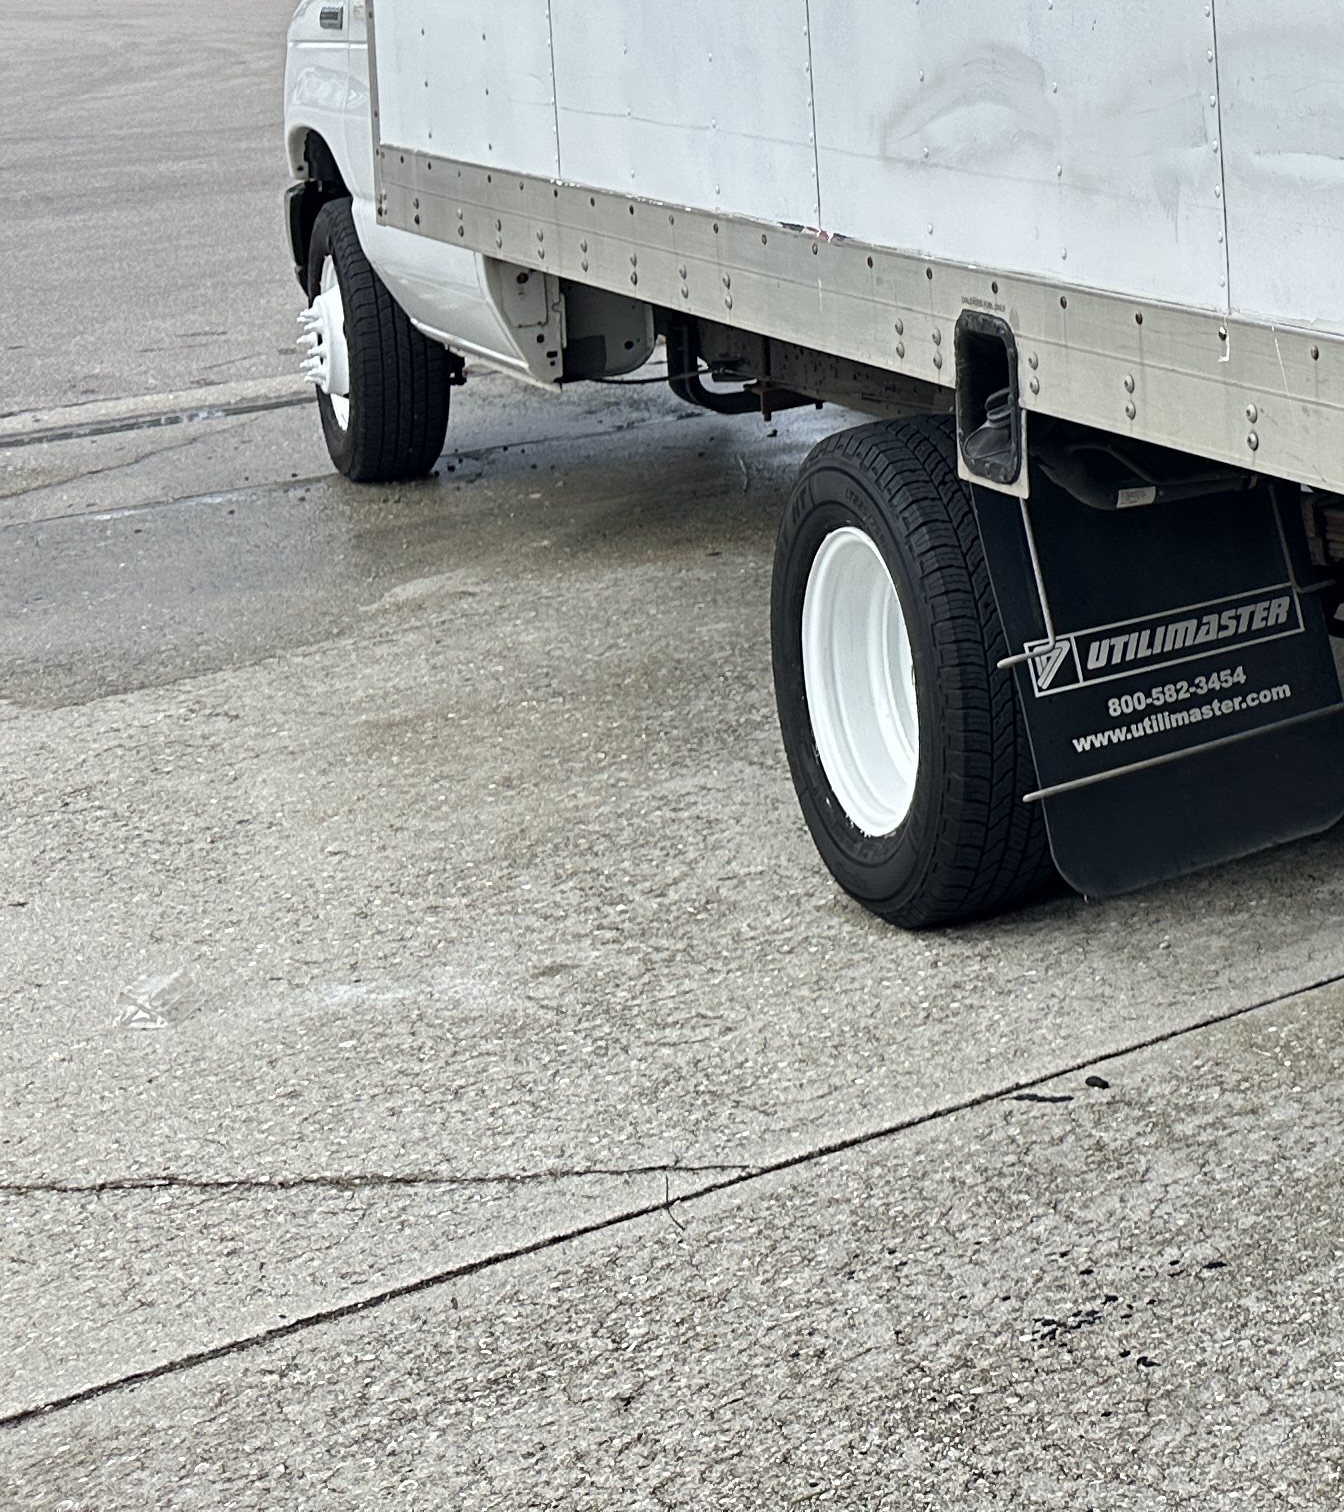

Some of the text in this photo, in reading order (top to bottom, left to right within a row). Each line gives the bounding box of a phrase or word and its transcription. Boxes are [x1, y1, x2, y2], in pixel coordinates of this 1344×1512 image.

[1087, 596, 1291, 670] UTILIMASTER
[1072, 681, 1292, 753] www.utilimaster.com
[1107, 665, 1247, 718] 800-582-3454
